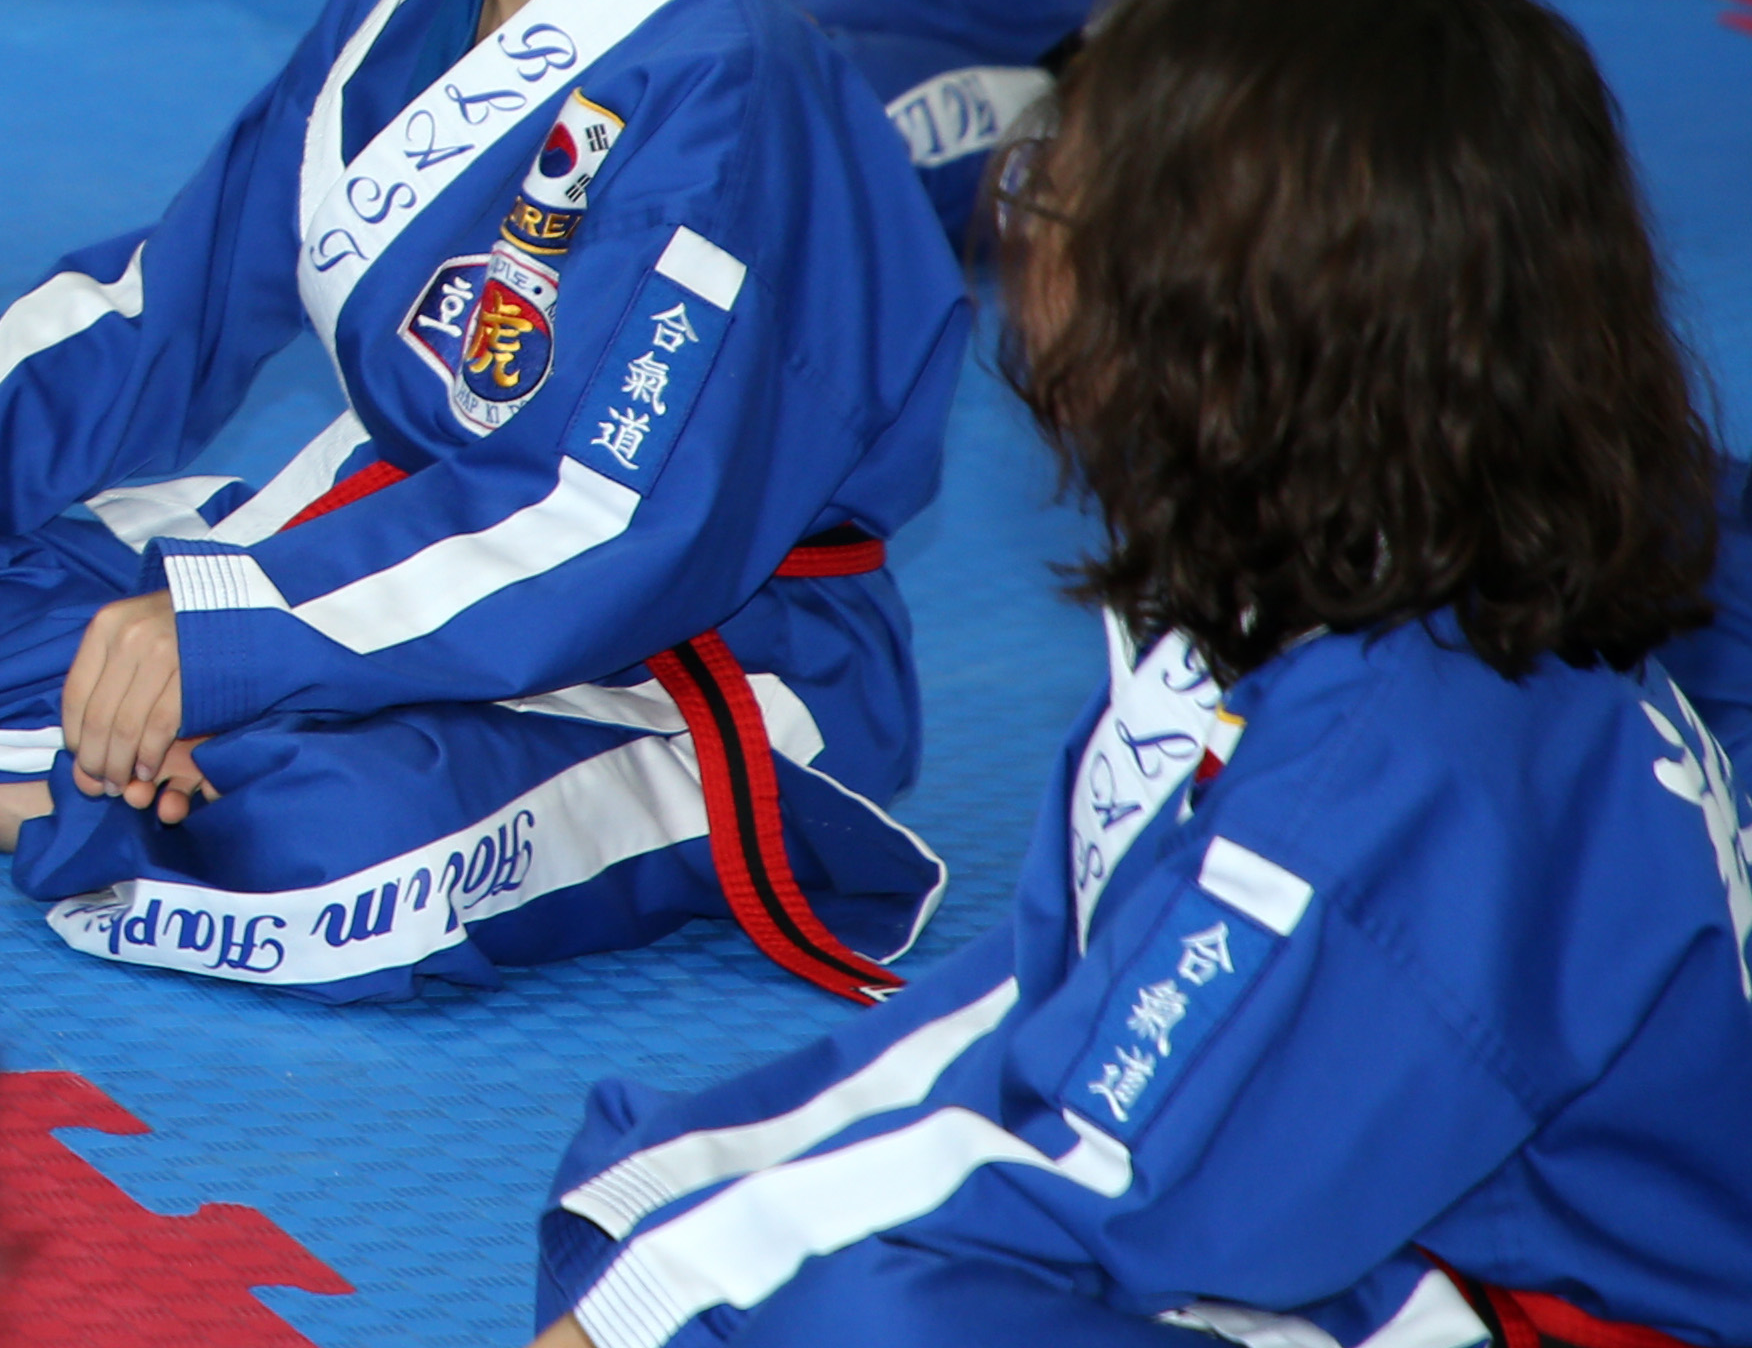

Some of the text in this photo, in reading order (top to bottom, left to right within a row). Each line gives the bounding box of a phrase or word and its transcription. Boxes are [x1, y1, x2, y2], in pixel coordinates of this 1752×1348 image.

[310, 22, 578, 272] BLAST
[416, 276, 474, 338] 호
[464, 289, 536, 389] 虎
[590, 302, 700, 471] 合氣道
